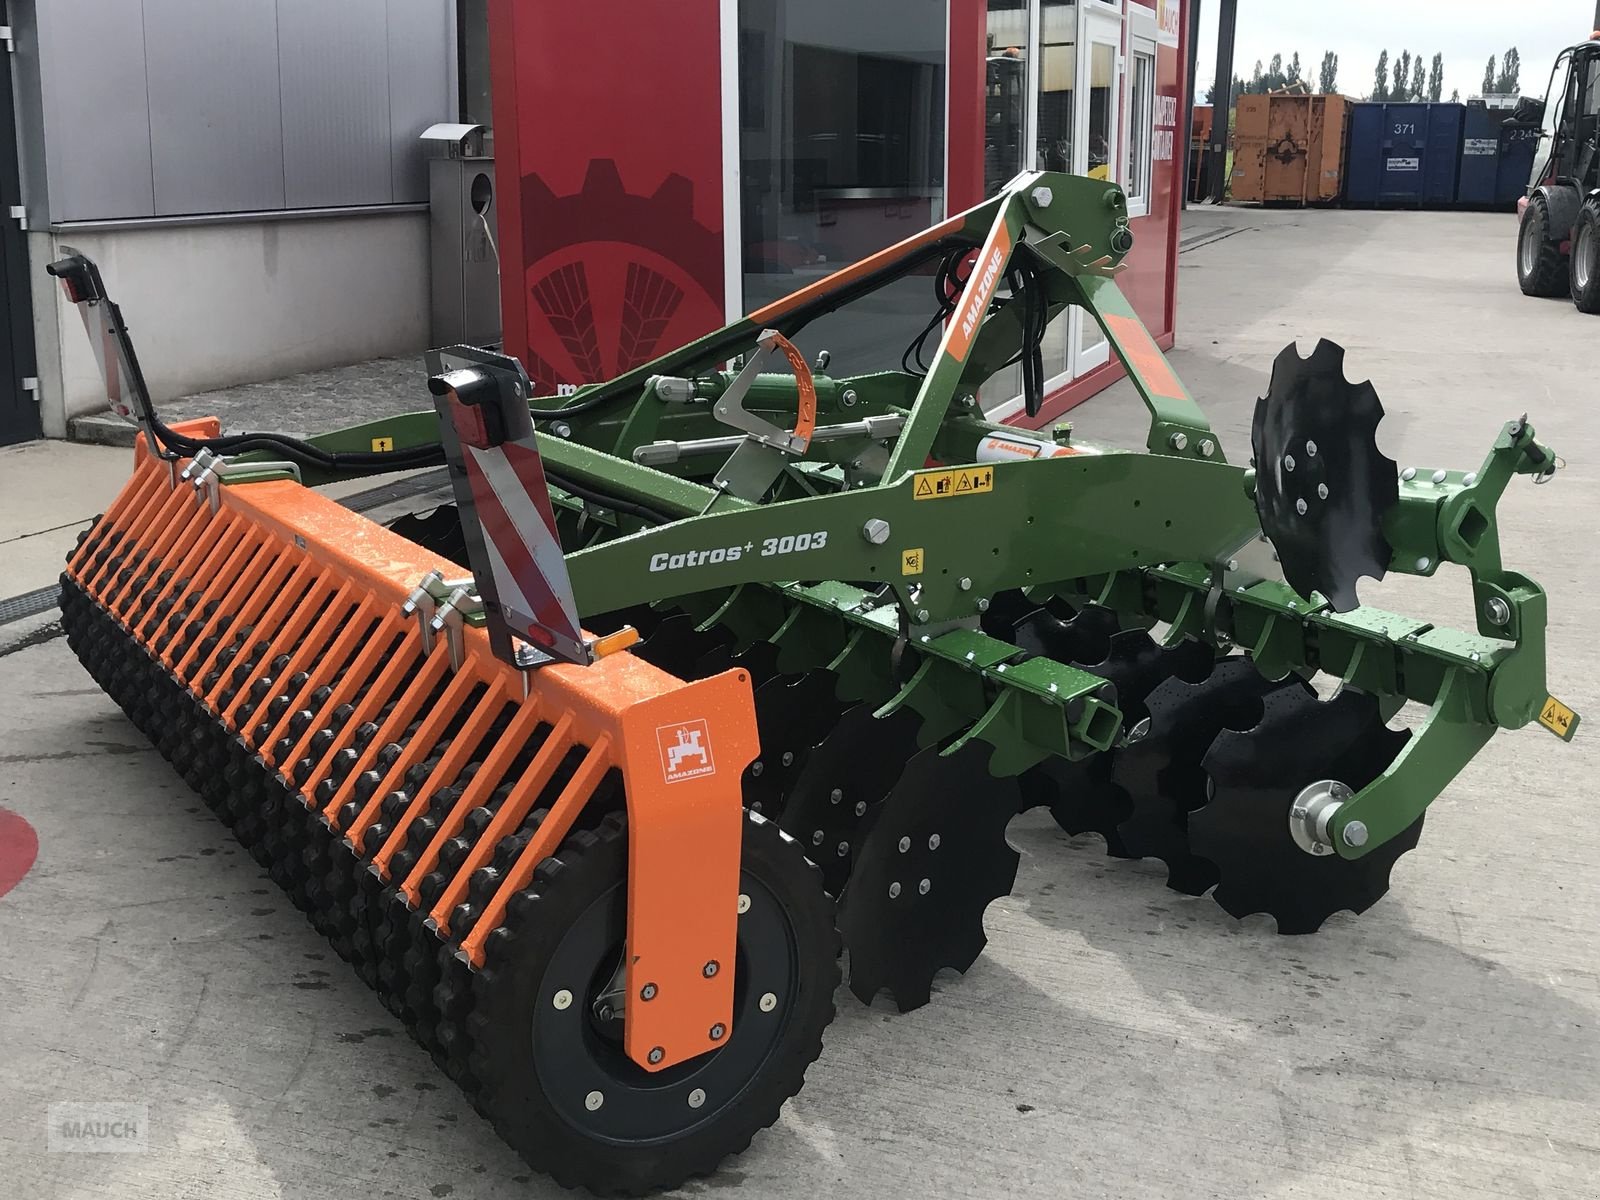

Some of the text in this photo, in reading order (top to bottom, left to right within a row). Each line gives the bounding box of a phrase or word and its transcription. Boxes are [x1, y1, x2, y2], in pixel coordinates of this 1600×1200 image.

[1394, 123, 1415, 135] 371
[962, 247, 1002, 340] AMAZONE
[761, 531, 828, 557] 3003
[667, 766, 712, 780] AMAZONE
